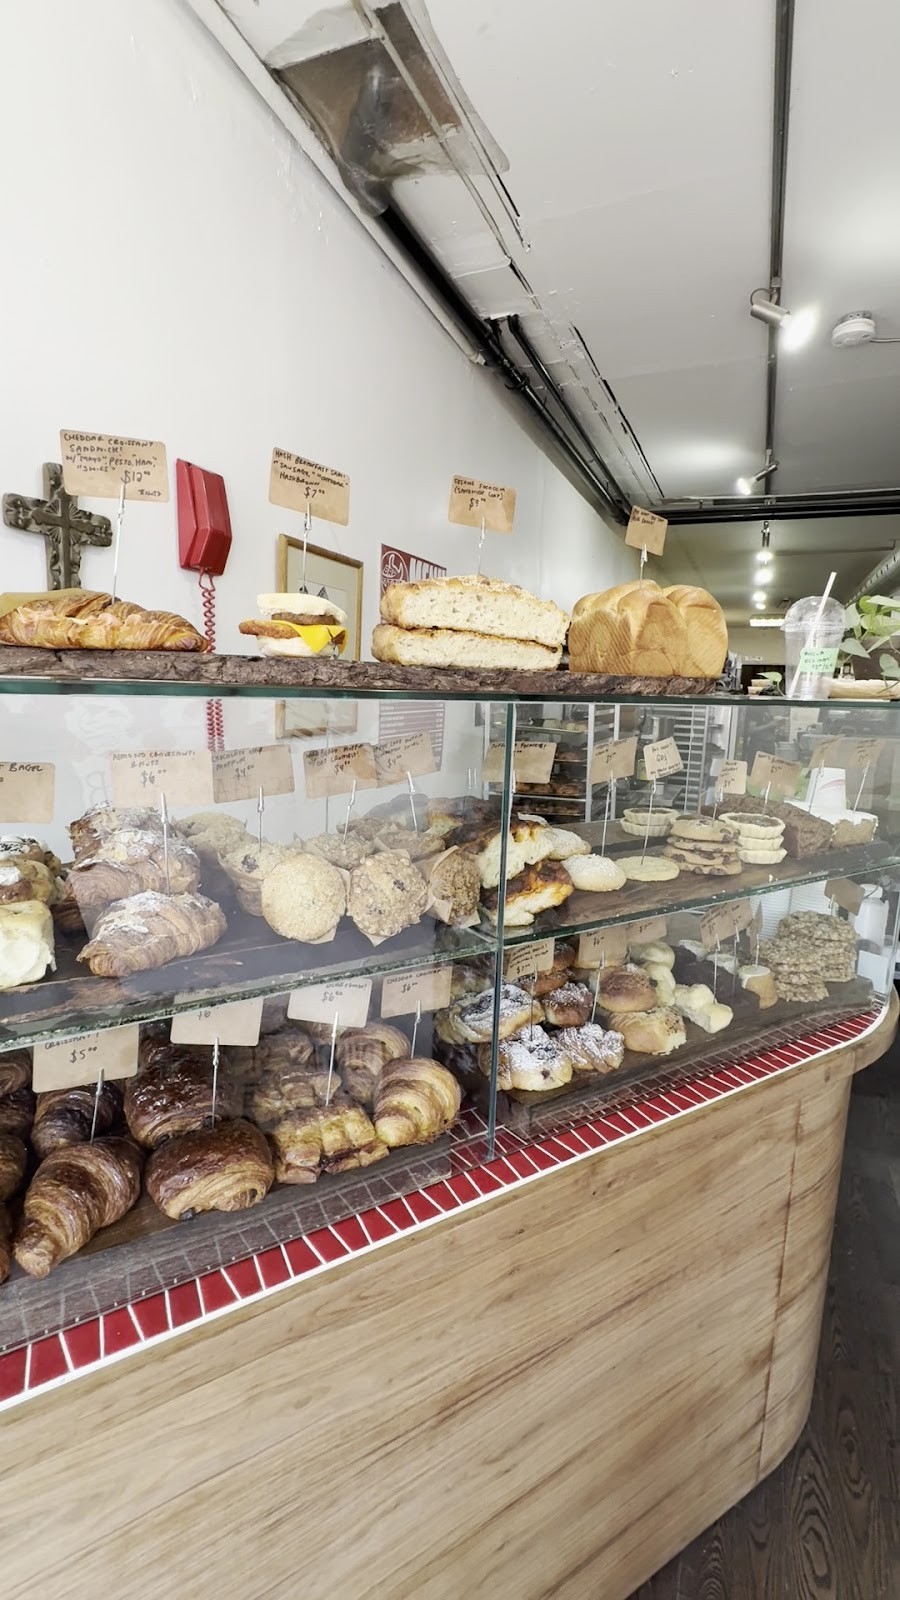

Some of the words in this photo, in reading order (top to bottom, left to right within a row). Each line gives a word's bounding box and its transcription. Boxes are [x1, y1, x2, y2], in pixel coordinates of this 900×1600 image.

[63, 433, 104, 442] CHEDDAR
[108, 438, 154, 448] CROISSANT
[275, 449, 292, 462] HASH
[294, 456, 329, 473] BREAKFAST
[279, 471, 320, 486] HASHBROWN
[211, 750, 245, 763] CHOCOLATE
[8, 762, 44, 773] BAGEL
